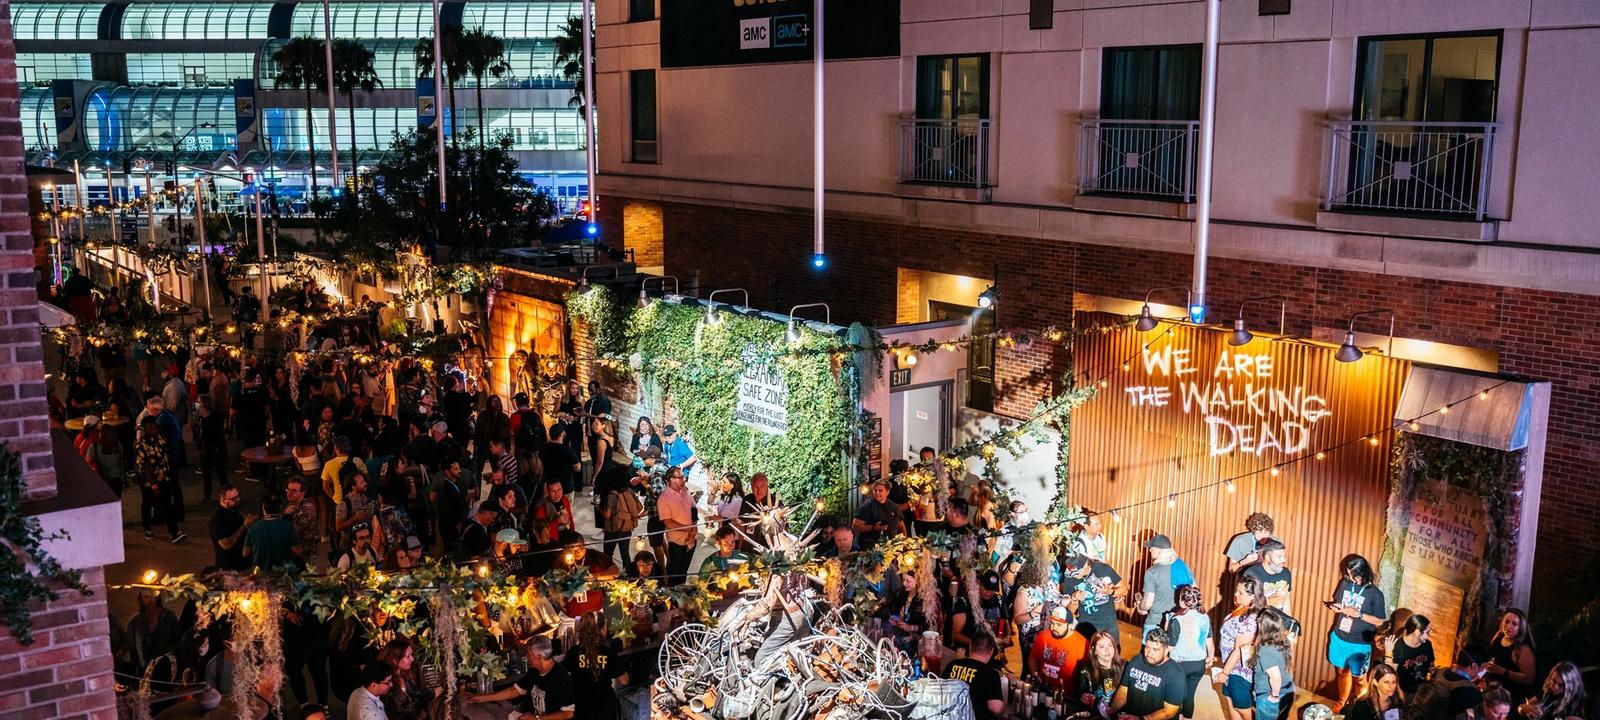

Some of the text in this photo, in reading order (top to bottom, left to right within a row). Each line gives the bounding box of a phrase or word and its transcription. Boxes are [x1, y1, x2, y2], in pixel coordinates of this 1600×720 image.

[1142, 343, 1274, 380] WE ARE
[893, 370, 908, 385] EXIT
[743, 383, 785, 408] SAFE ZONE
[1124, 382, 1332, 424] THE WALKING
[1204, 416, 1309, 457] DEAD
[1415, 513, 1478, 542] COMMUNITY
[1423, 504, 1473, 529] FOR ALL
[1408, 532, 1432, 548] THOSE
[1434, 542, 1453, 556] WHO
[1419, 526, 1473, 552] FOR ALL
[1408, 545, 1468, 575] SURVIVE
[578, 654, 608, 670] SFF
[950, 664, 978, 684] STAFF
